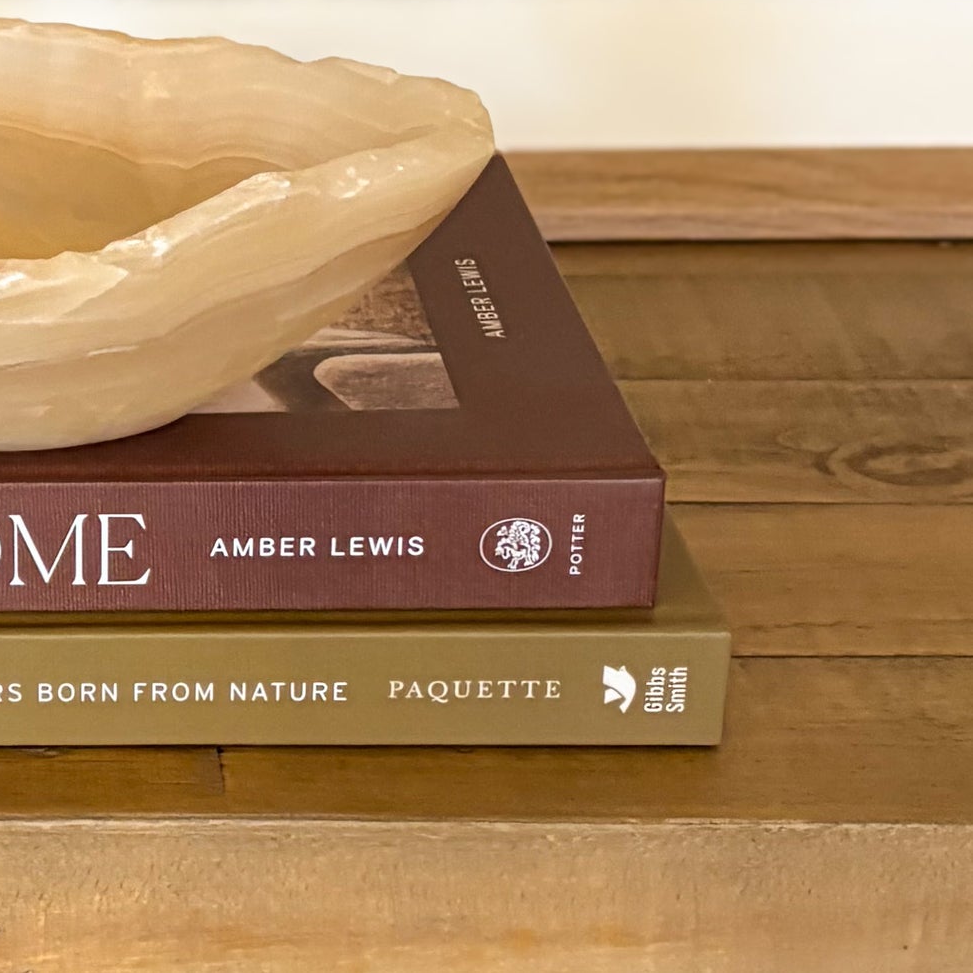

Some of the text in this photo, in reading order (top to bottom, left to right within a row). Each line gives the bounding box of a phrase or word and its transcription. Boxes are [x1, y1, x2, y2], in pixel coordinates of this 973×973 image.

[454, 258, 507, 338] AMBER LEWIS
[209, 535, 424, 557] AMBER LEWIS
[569, 513, 586, 575] POTTER
[38, 682, 118, 703] BORN
[133, 682, 214, 702] FROM
[230, 681, 348, 702] NATURE
[388, 680, 562, 704] PAQUETTE
[643, 667, 666, 713] Gibbs
[666, 667, 688, 713] Smith
